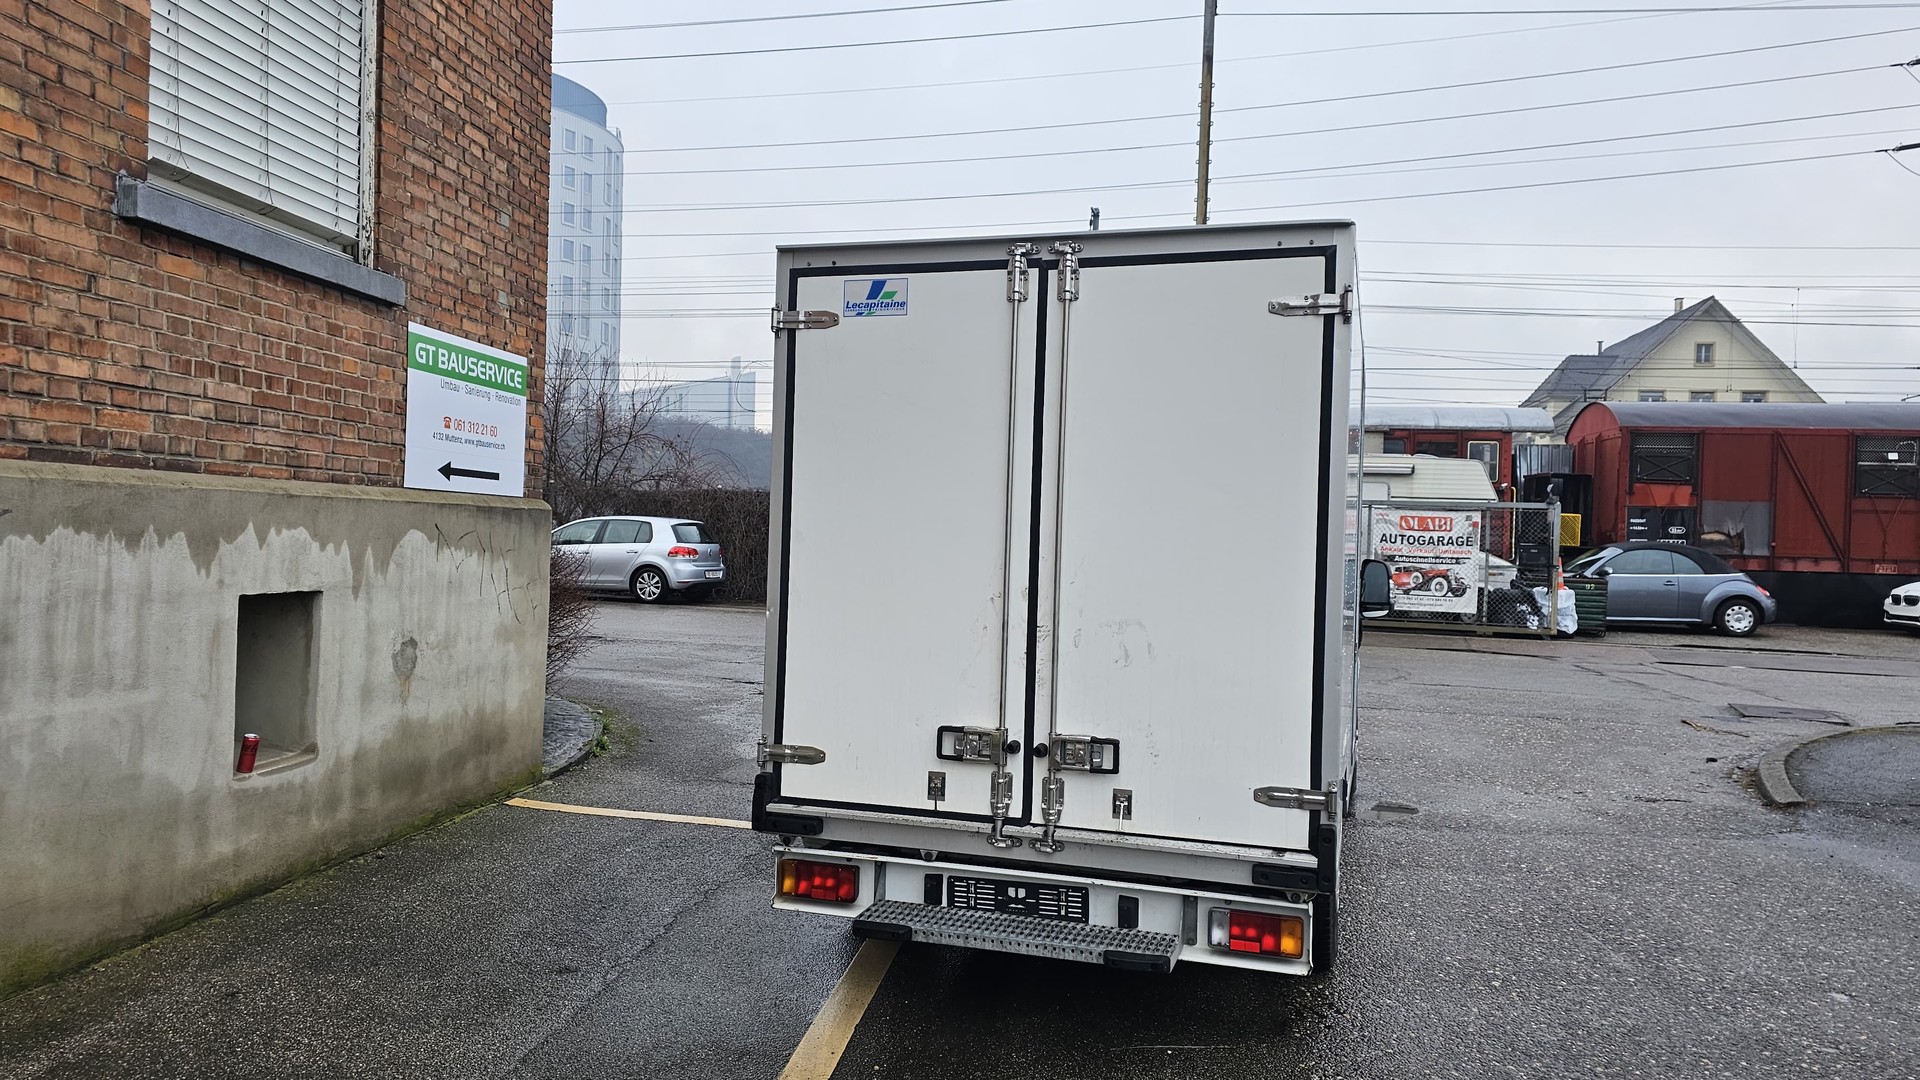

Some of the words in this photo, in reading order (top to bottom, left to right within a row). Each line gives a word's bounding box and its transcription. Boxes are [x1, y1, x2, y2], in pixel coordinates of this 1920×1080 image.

[845, 300, 906, 311] Lecapitaine
[415, 342, 436, 366] GT
[438, 349, 522, 389] BAUSERVICE
[440, 378, 460, 393] Umbau
[464, 384, 491, 402] Sanierung
[494, 391, 522, 407] Renovation
[453, 418, 466, 432] 061
[467, 421, 480, 435] 312
[480, 423, 489, 436] 21
[489, 425, 498, 438] 60
[432, 431, 444, 441] 4132
[445, 433, 464, 445] Muttenz,
[464, 438, 506, 451] www.gtbauservice.ch
[1401, 516, 1451, 531] OLABI
[1379, 533, 1474, 546] AUTOGARAGE
[1394, 555, 1457, 564] Autoschnellservice
